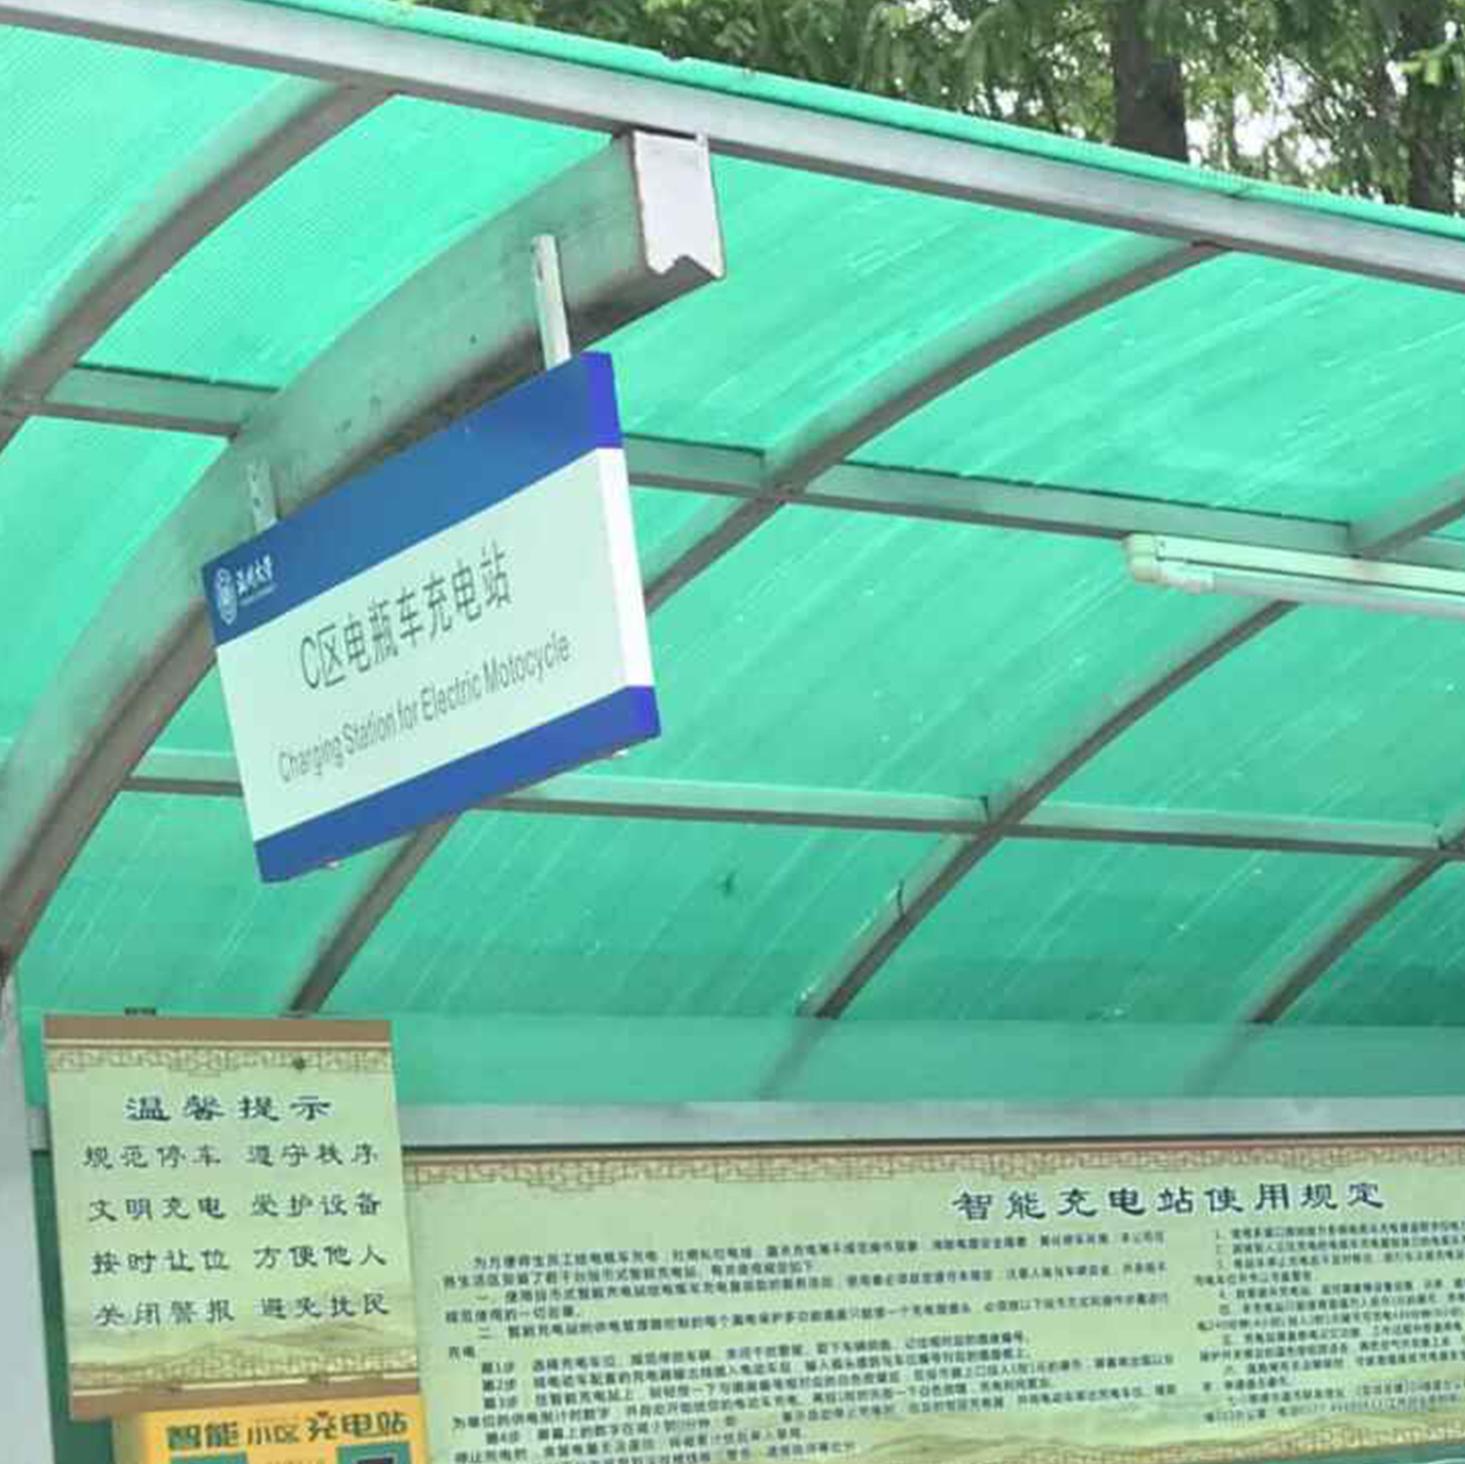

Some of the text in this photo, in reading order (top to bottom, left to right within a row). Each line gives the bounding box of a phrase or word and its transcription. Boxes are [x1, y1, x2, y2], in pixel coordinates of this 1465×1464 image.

[300, 540, 511, 690] C区电瓶车充电站
[278, 630, 572, 783] Charging Station for Electric Motocycle
[125, 1095, 331, 1122] 温馨提示
[83, 1141, 379, 1170] 规范停车 遵守秩序
[89, 1192, 382, 1222] 文明充电 爱护设备
[953, 1181, 1384, 1221] 智能充电站使用规定
[91, 1244, 388, 1275] 按时让位 方便他人
[95, 1292, 390, 1327] 关闭警报 避免扰民
[166, 1410, 408, 1449] 智能小区充电站
